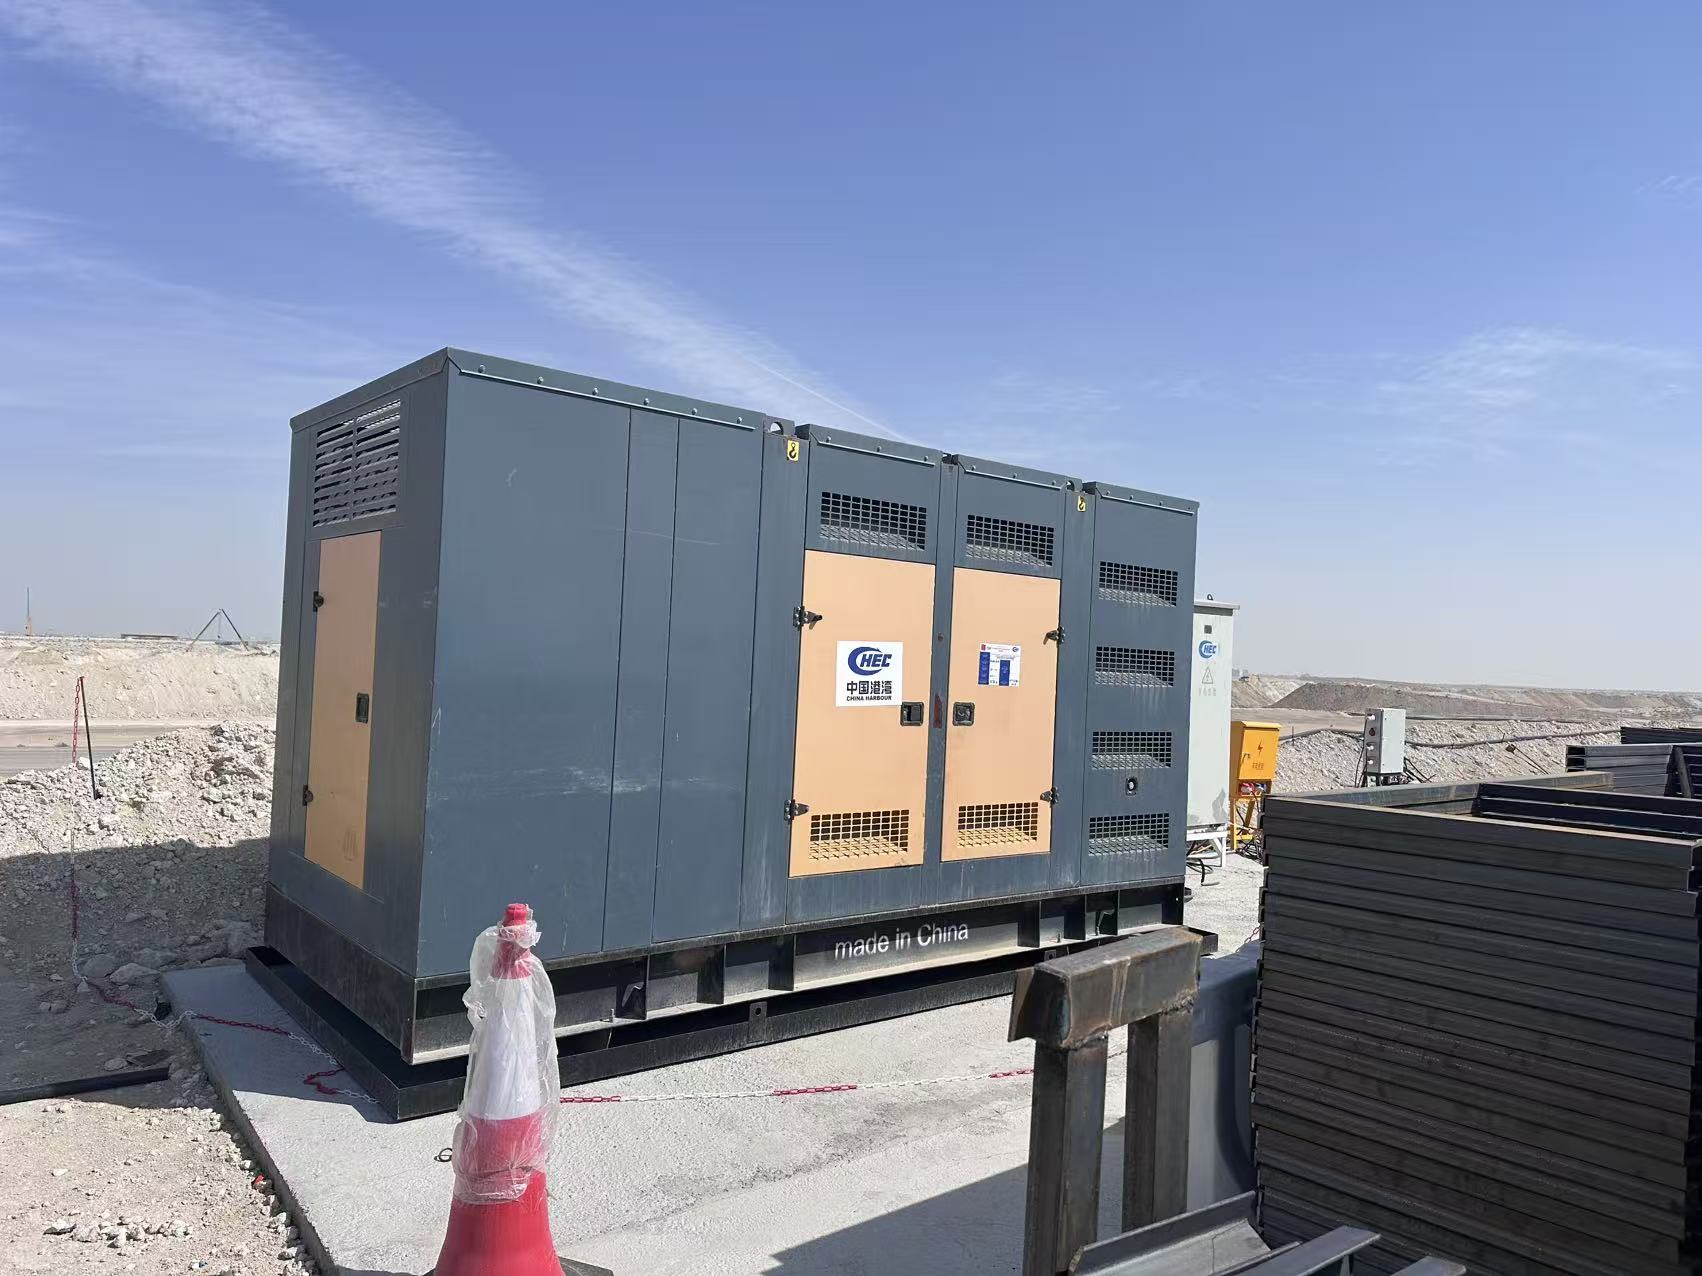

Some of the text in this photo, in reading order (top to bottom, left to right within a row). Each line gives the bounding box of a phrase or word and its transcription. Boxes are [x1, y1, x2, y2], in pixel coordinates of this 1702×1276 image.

[848, 646, 892, 676] CHEC
[1199, 640, 1217, 658] CHEC
[846, 680, 892, 695] 中国港湾
[834, 922, 969, 959] made in China
